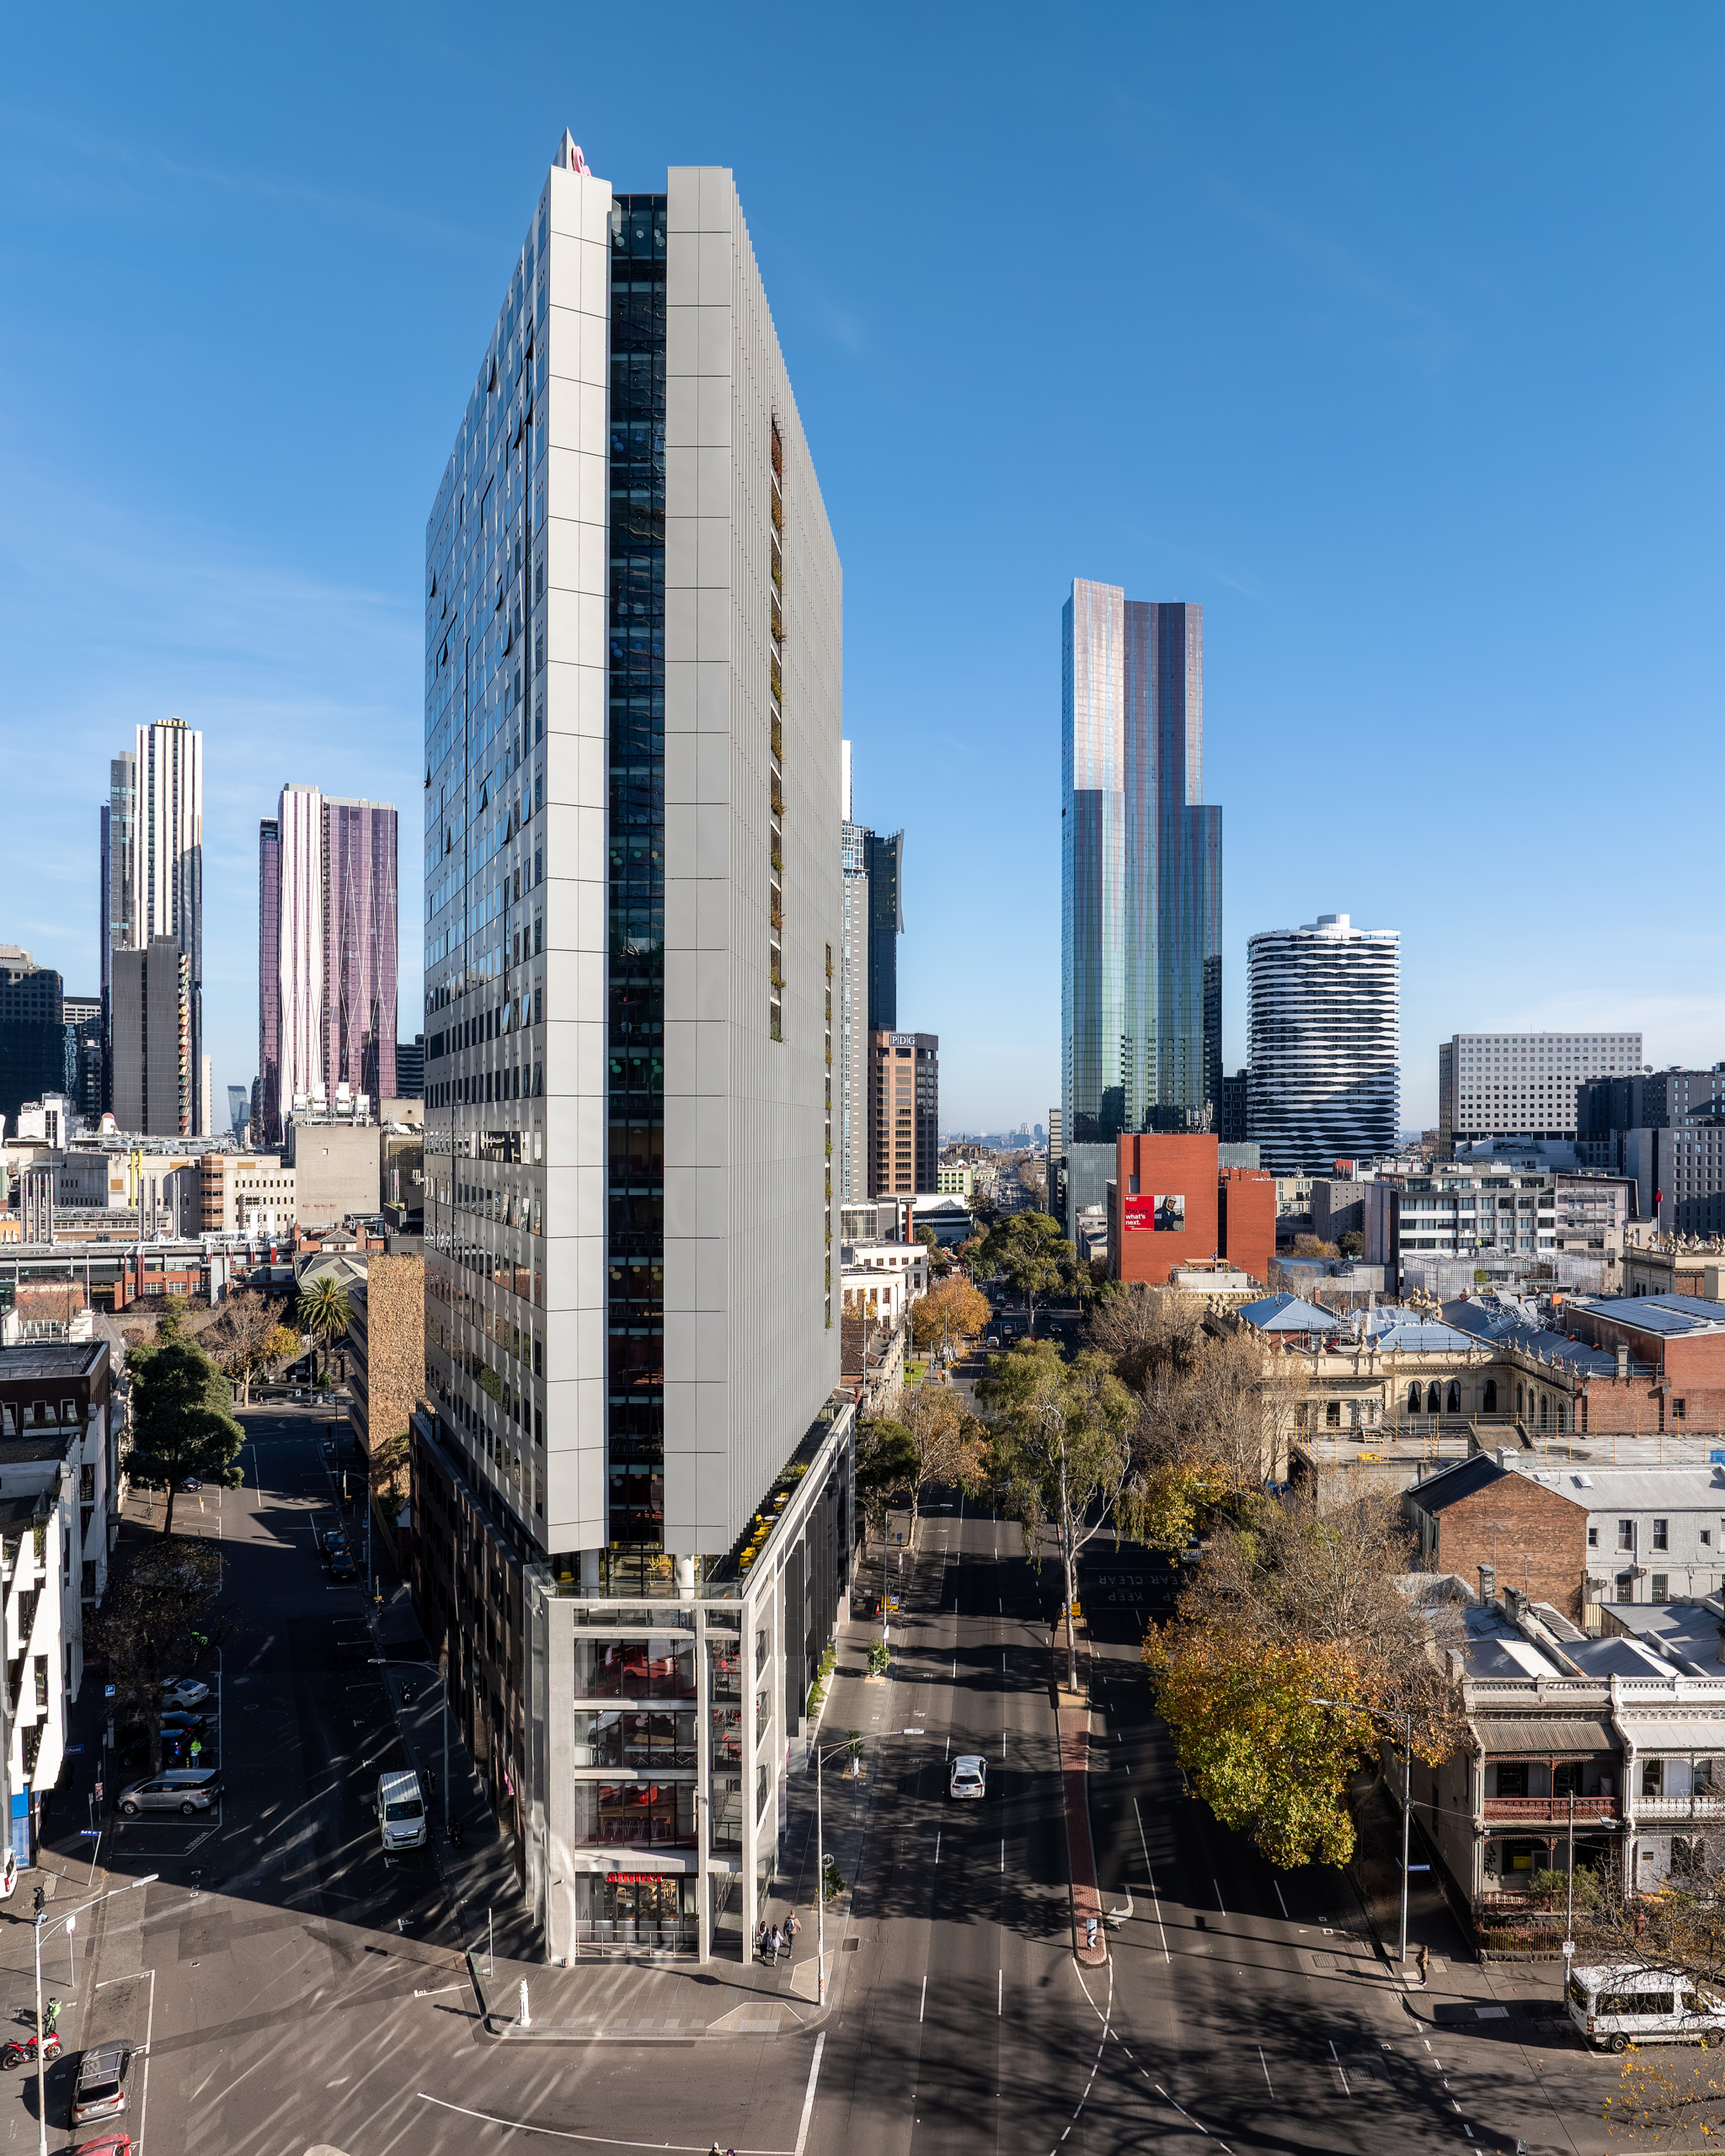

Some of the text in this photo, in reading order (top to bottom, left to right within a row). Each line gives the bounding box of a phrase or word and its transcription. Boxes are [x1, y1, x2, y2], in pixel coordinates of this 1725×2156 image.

[891, 1036, 916, 1045] PDG
[1098, 1575, 1143, 1585] CLEAR
[1108, 1592, 1144, 1602] KEEP
